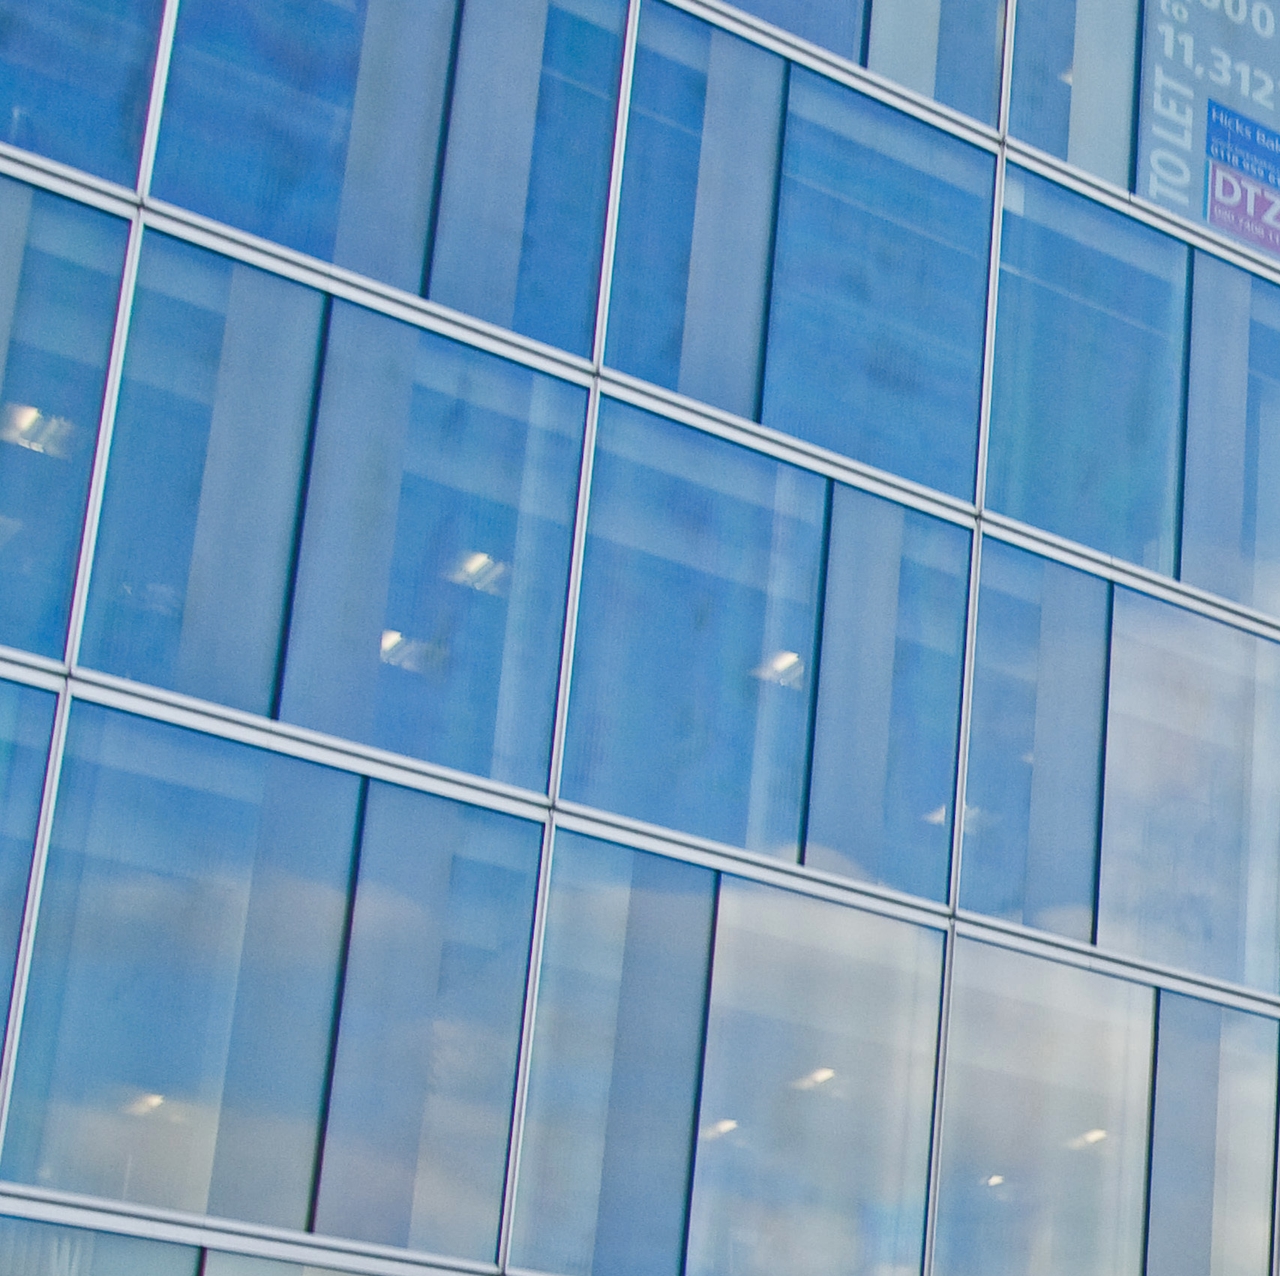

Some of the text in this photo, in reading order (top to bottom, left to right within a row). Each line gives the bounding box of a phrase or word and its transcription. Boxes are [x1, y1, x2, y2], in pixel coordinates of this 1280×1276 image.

[1158, 22, 1275, 111] 11,312
[1150, 64, 1195, 207] TO LET
